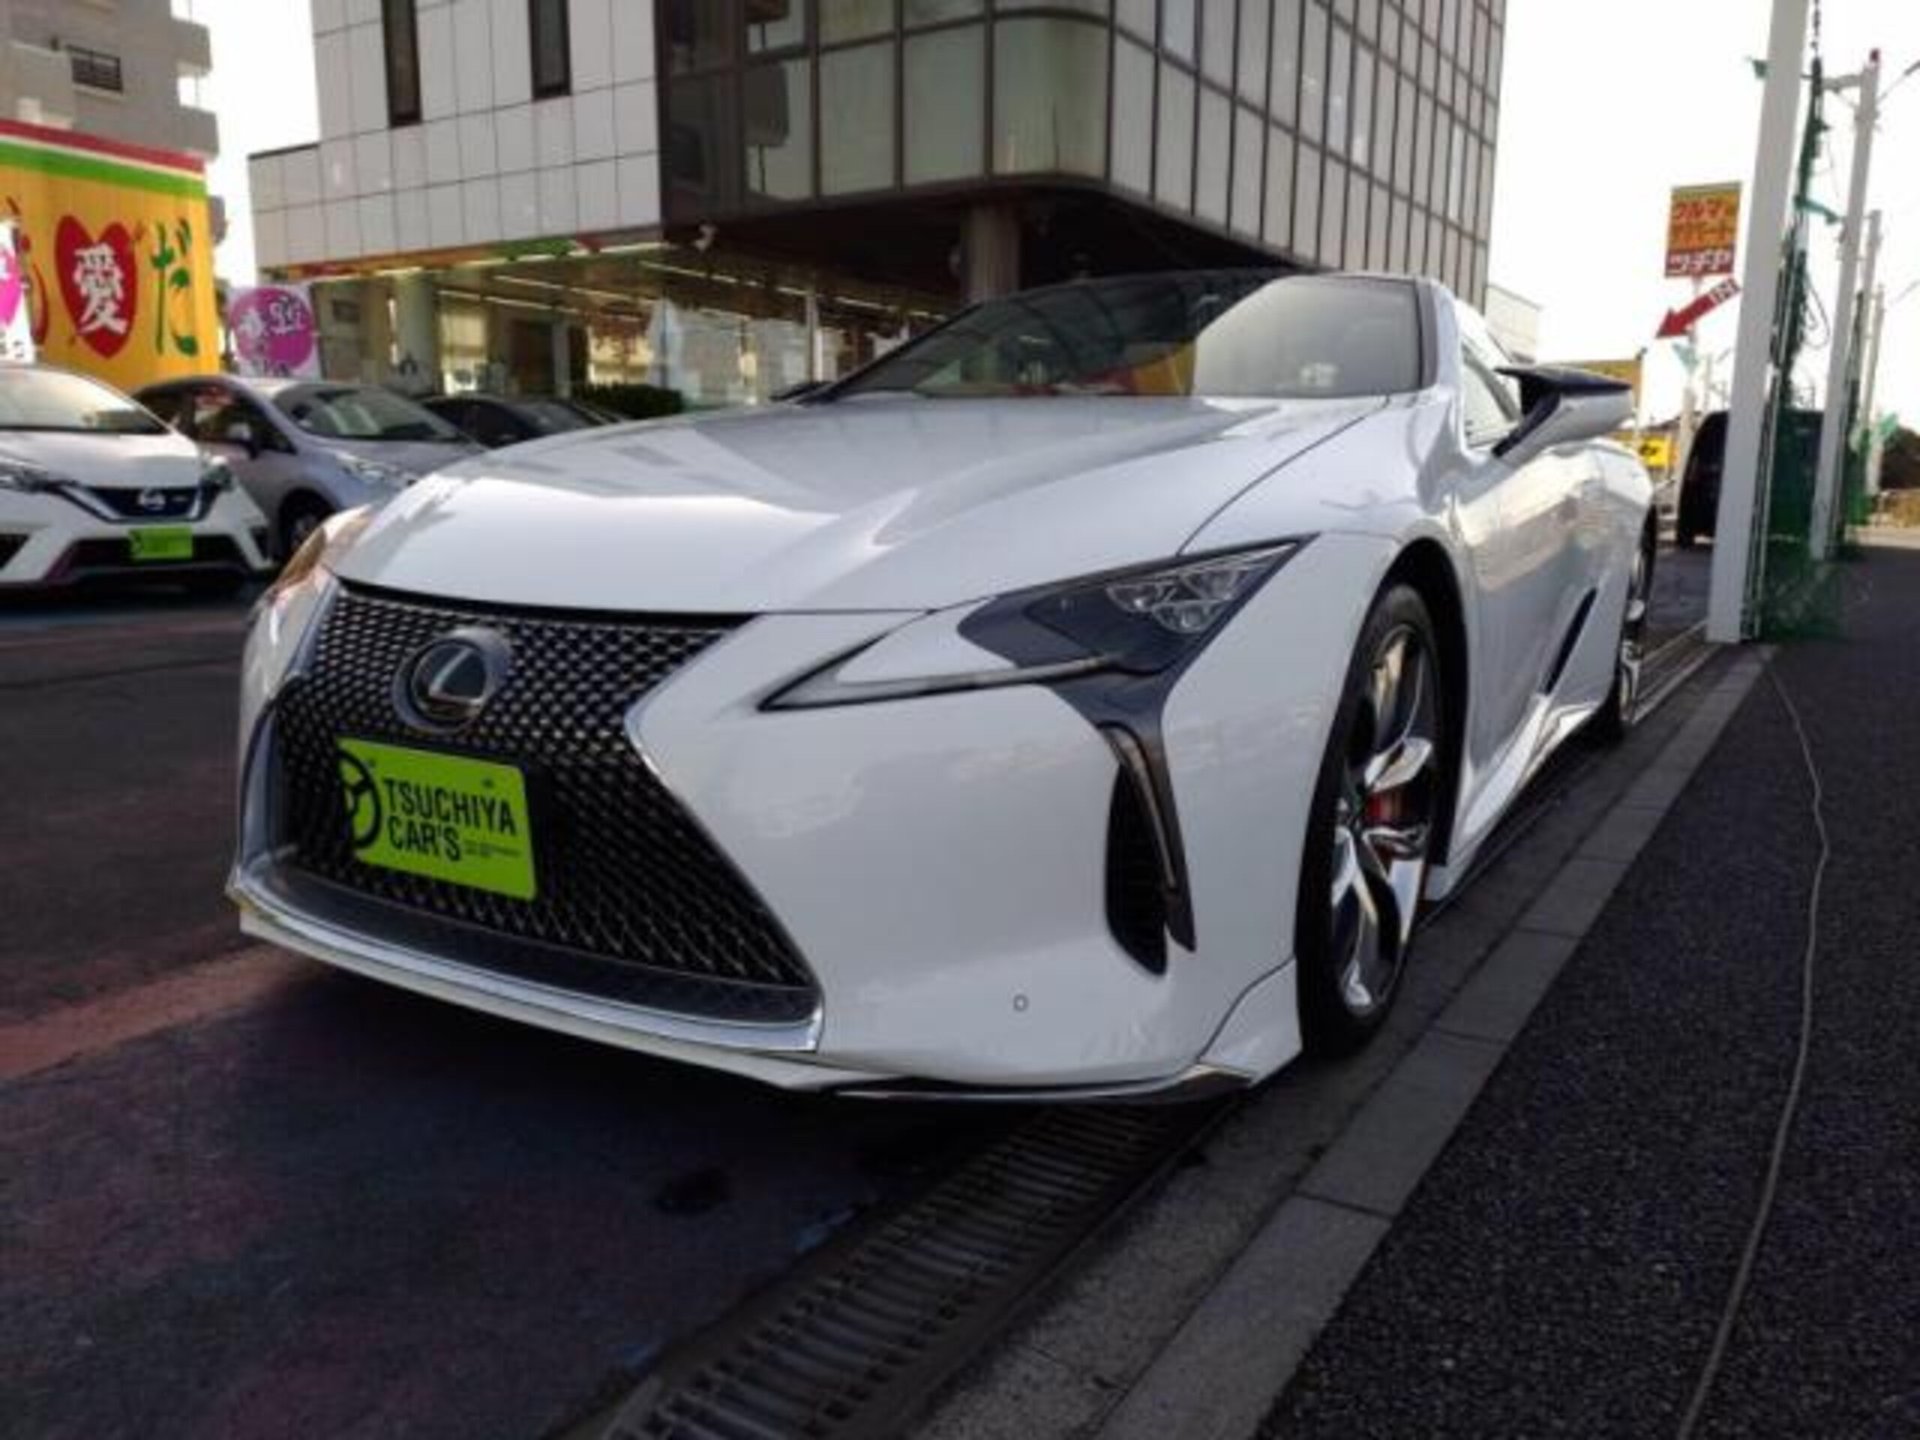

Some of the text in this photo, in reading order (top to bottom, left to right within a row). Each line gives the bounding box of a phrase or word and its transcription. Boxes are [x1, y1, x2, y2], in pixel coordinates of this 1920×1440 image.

[1667, 250, 1732, 275] ツチヤ
[384, 778, 516, 836] TSUCHIYA
[387, 815, 461, 861] CAR'S
